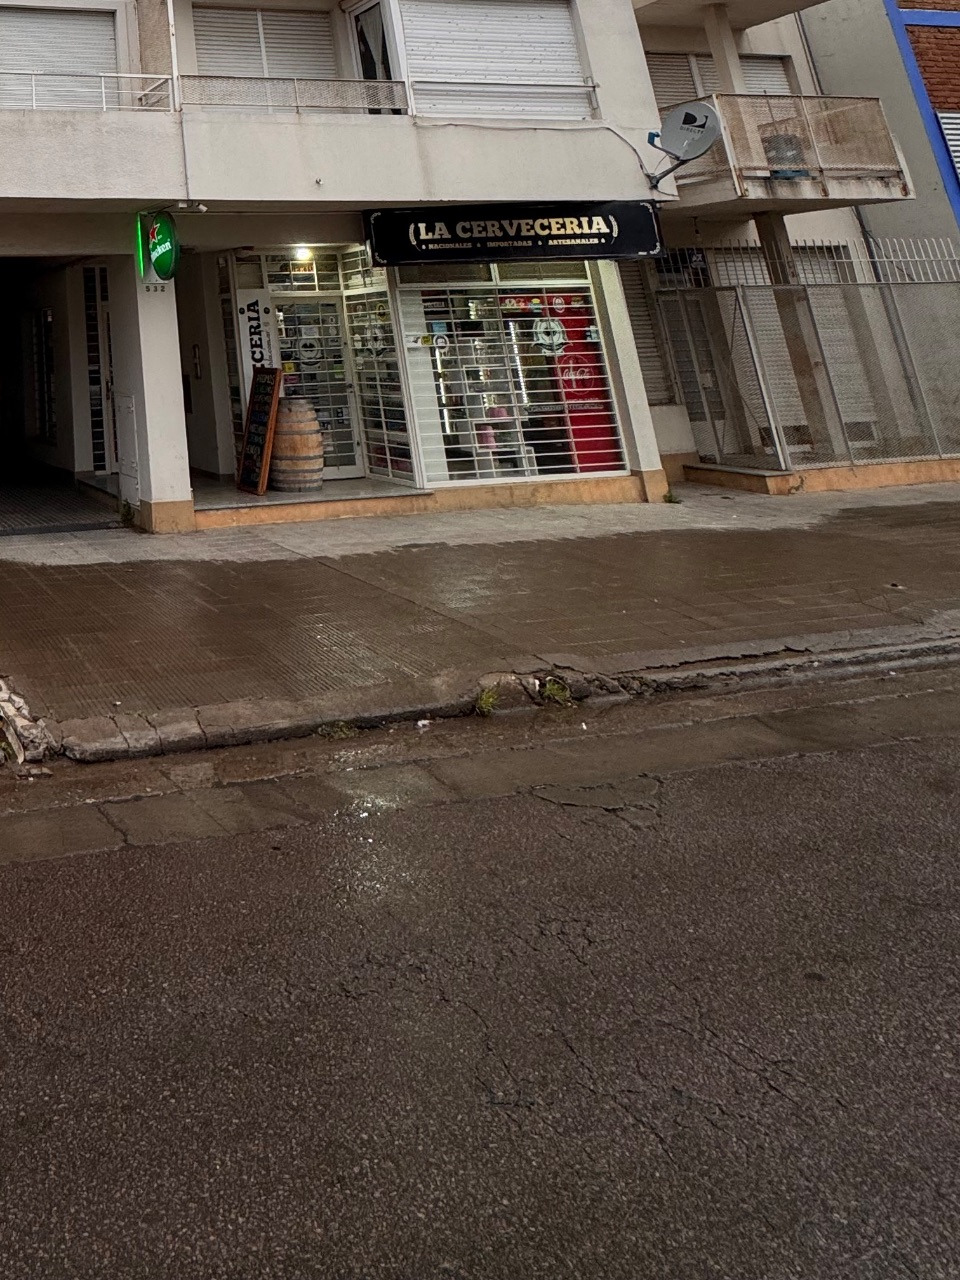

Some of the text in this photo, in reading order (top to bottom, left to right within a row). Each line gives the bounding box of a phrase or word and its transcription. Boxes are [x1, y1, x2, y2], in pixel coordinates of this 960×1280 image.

[417, 216, 610, 239] LA CERVECERIA
[428, 238, 599, 250] NACIONALES IMPORTADAS ARTESANALES
